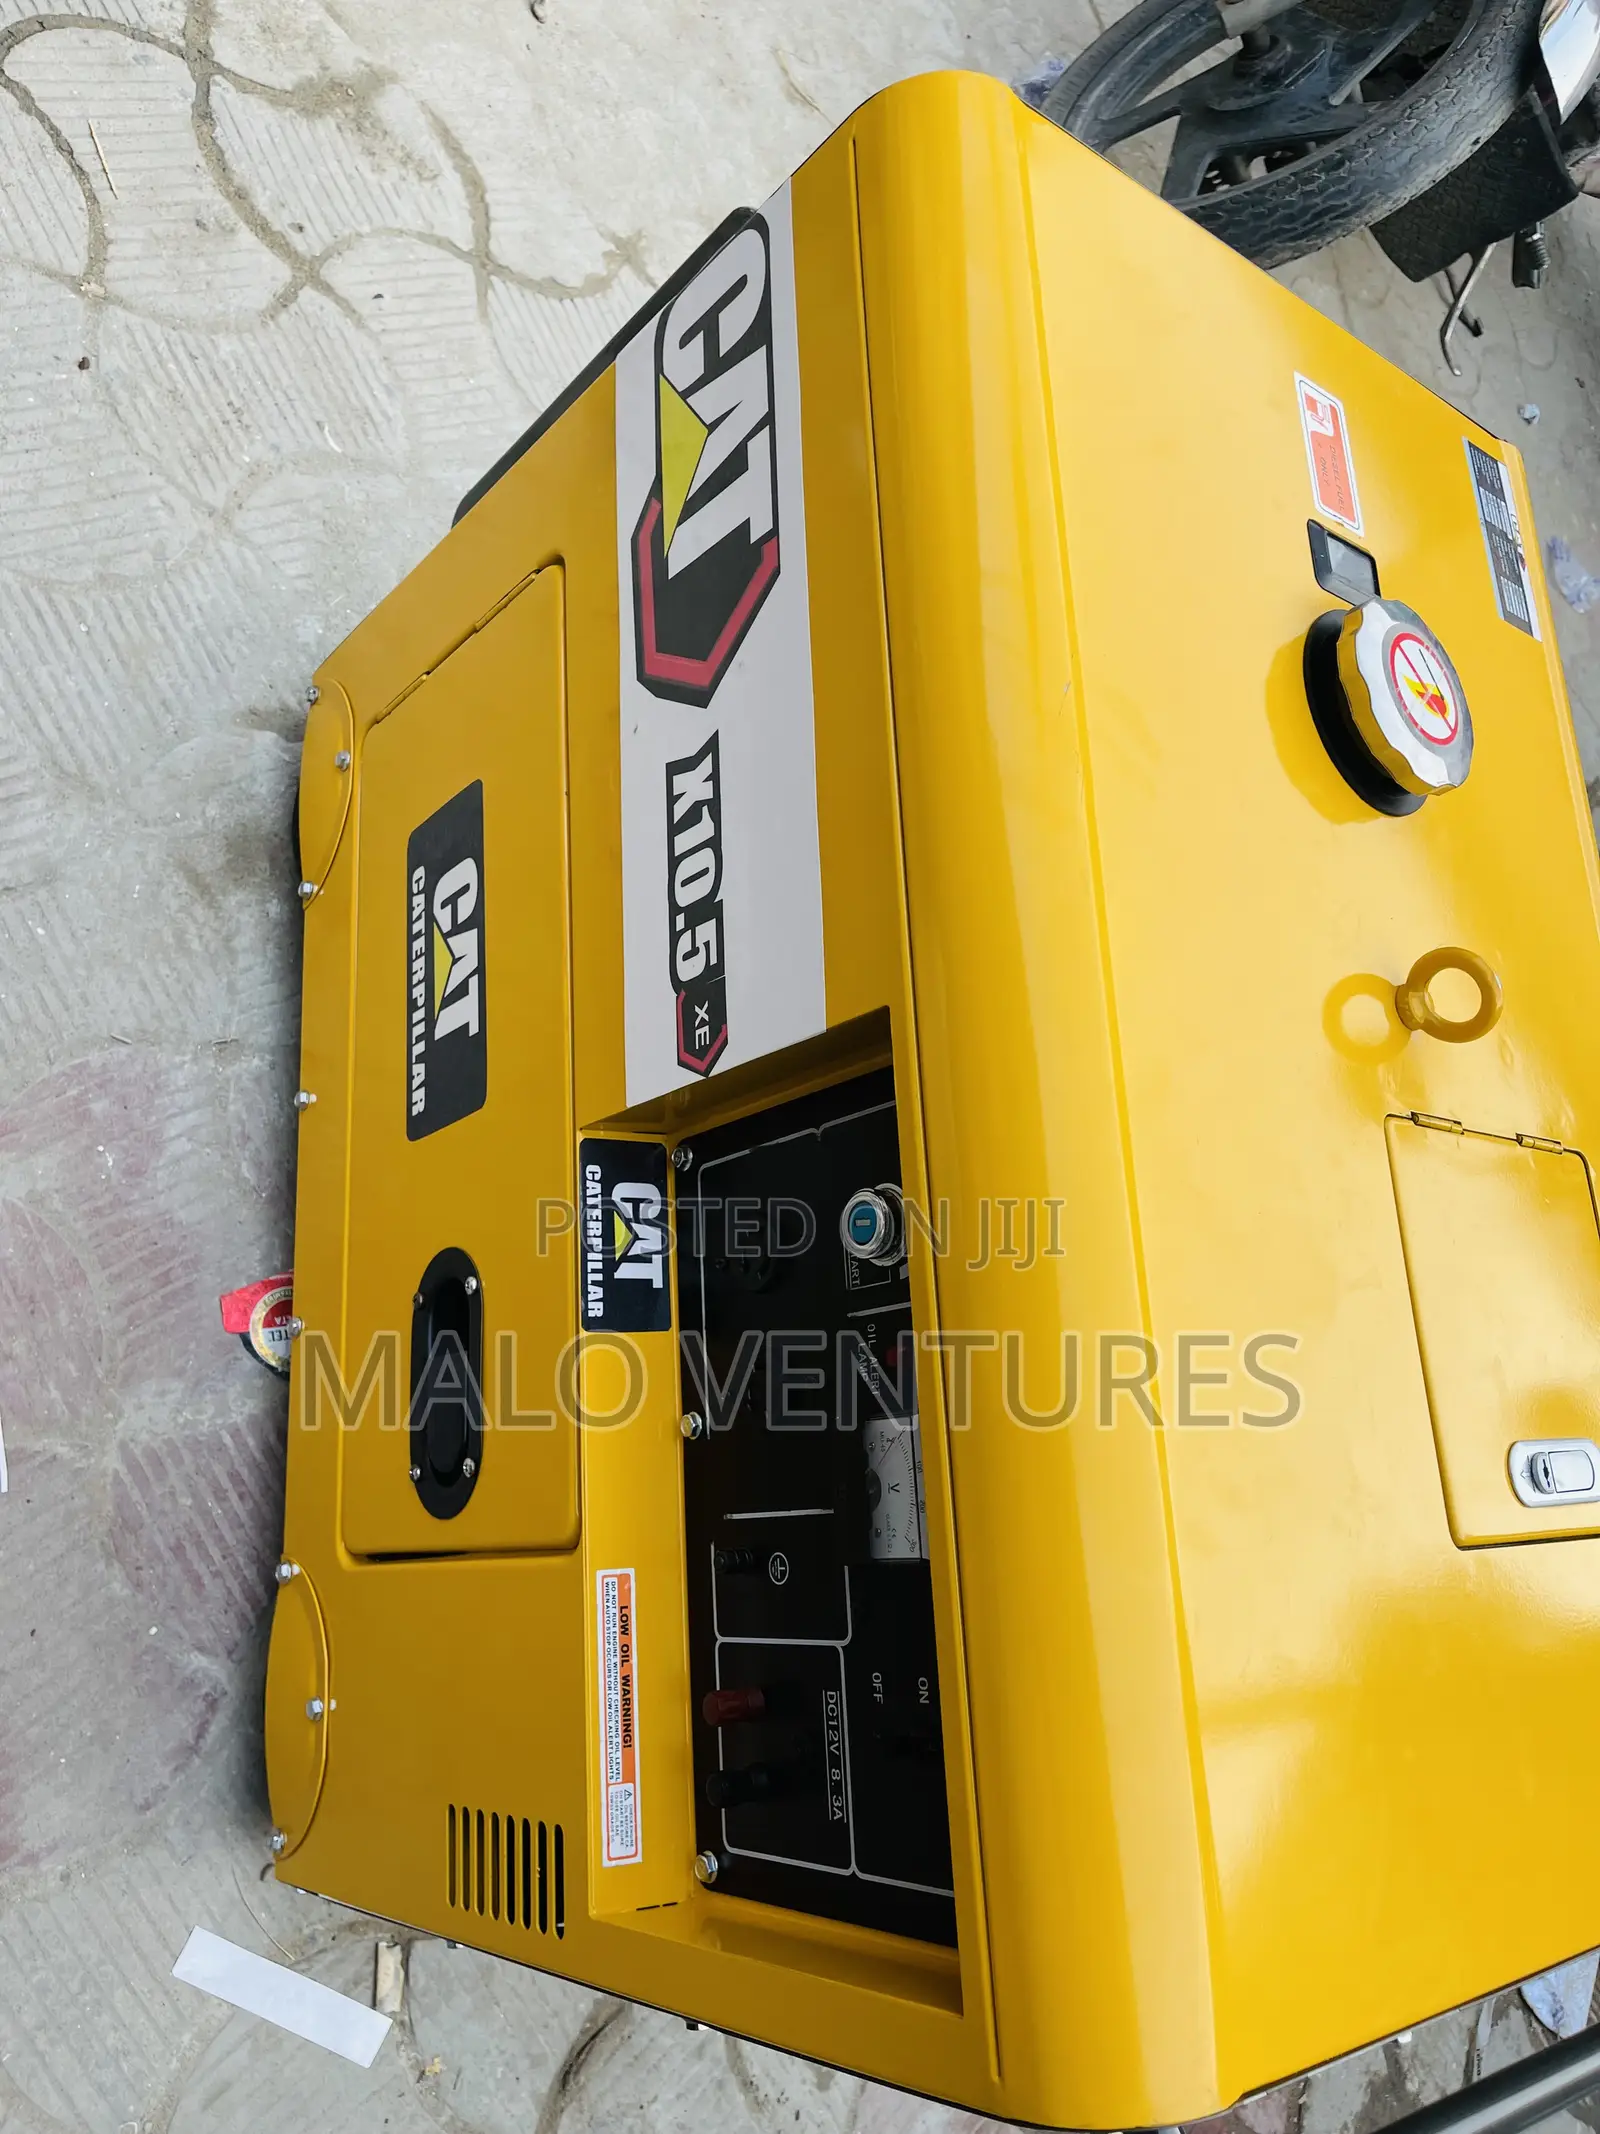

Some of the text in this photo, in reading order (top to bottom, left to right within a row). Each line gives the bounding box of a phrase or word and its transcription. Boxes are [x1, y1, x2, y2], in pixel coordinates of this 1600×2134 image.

[662, 228, 774, 580] CAT
[1329, 444, 1345, 512] DIESEL FUEL
[672, 751, 718, 1050] X10.5 XE
[433, 856, 480, 1041] CAT
[411, 865, 427, 1117] CATERPILLAR
[585, 1164, 605, 1319] CATERPILLAR
[611, 1181, 664, 1289] CAT
[858, 1342, 869, 1381] LAMP
[867, 1323, 881, 1397] OIL ALERT
[610, 1581, 616, 1592] DO
[607, 1680, 613, 1691] OR
[620, 1605, 632, 1749] LOW OIL WARNING!
[871, 1672, 883, 1704] OFF
[917, 1677, 929, 1704] ON
[826, 1691, 840, 1756] DC12V
